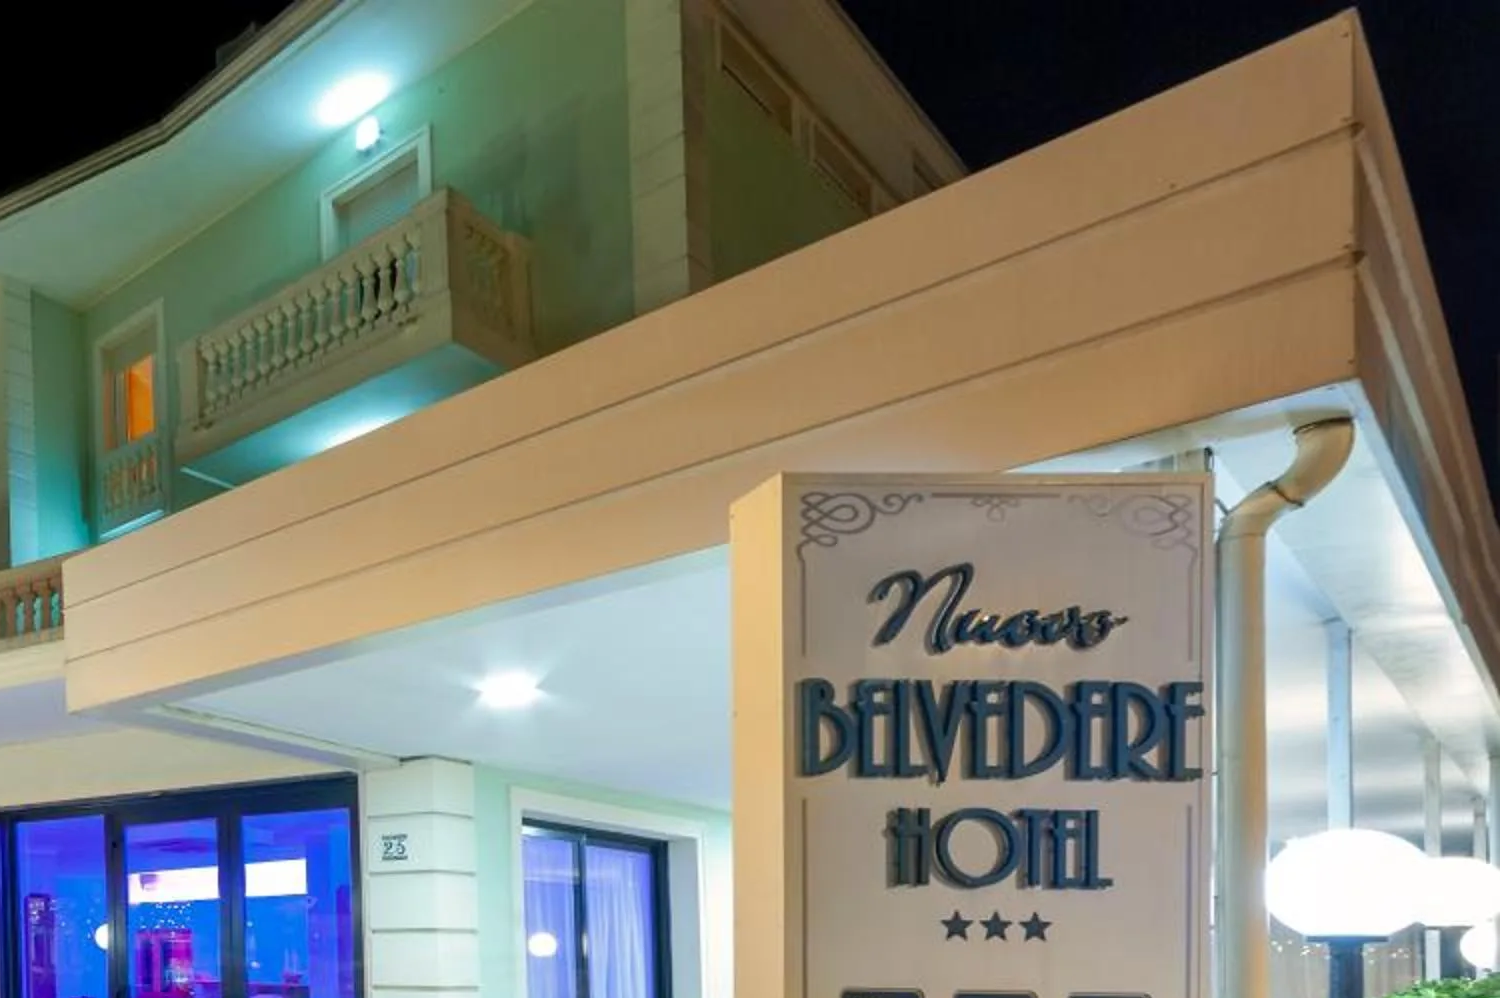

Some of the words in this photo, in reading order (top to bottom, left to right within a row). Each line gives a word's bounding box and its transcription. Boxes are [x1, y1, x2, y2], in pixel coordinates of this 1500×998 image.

[866, 562, 1129, 656] Nuovo
[796, 677, 1205, 786] BELVEDERE
[882, 807, 1114, 889] HOTEL
